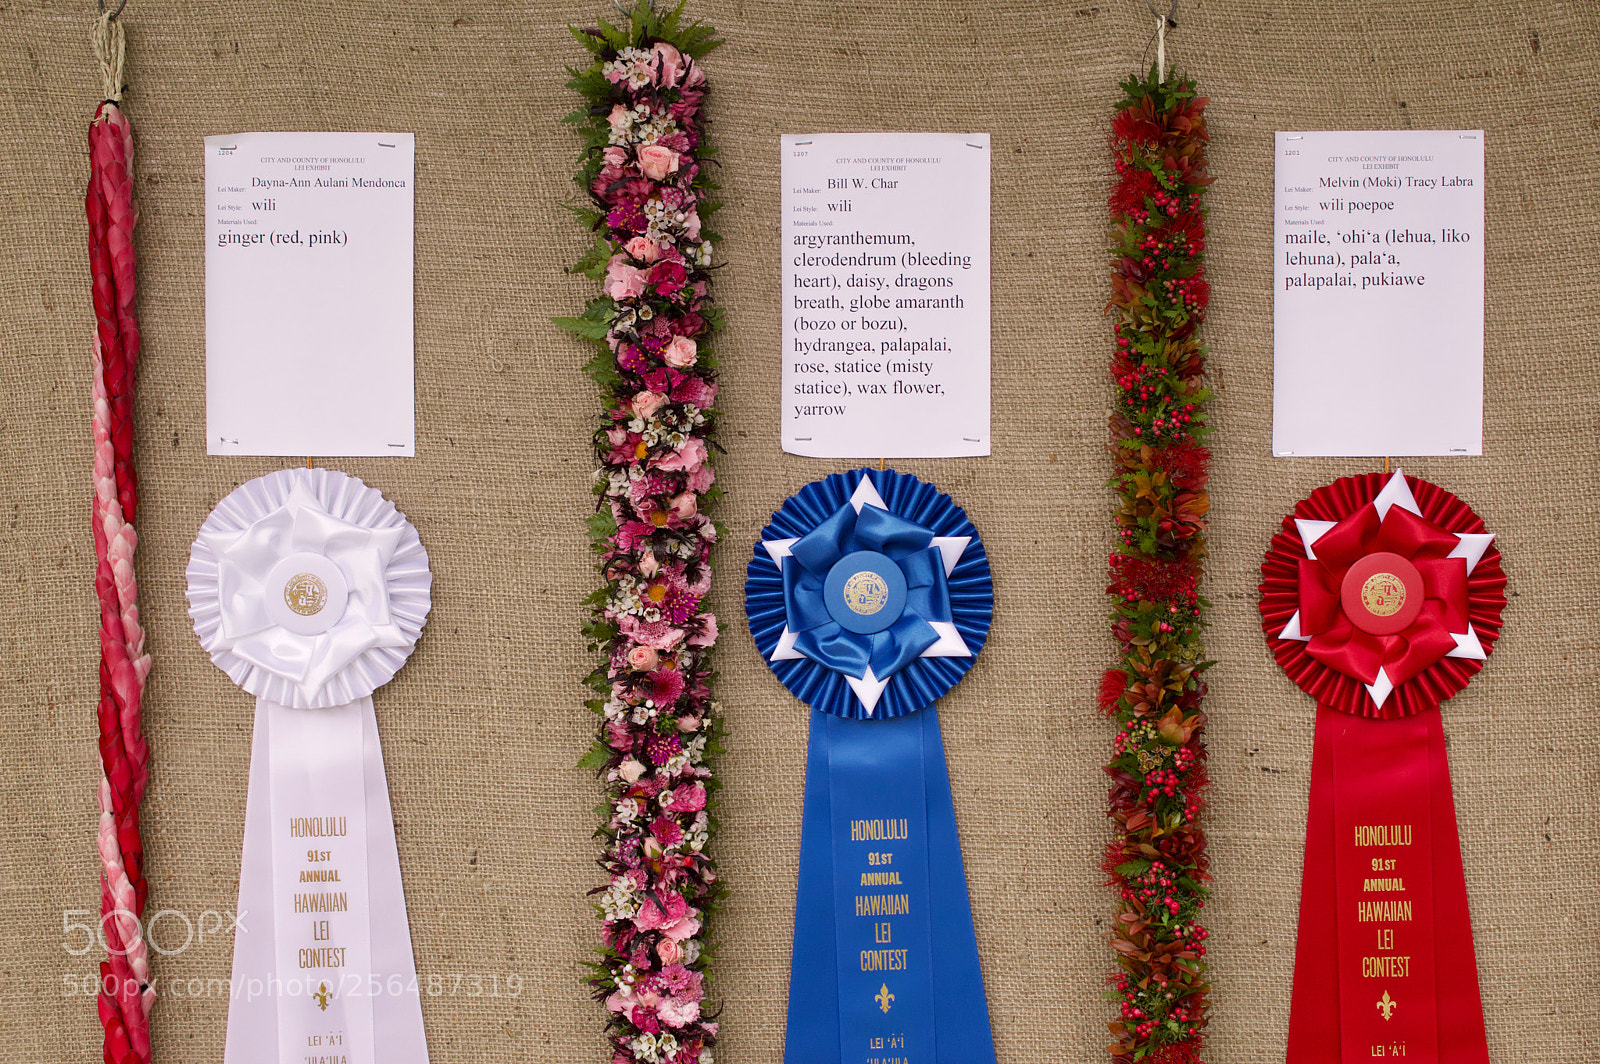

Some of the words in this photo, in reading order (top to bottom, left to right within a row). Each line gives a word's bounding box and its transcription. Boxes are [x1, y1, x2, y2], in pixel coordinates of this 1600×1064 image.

[252, 177, 310, 190] Dayna-Ann
[314, 177, 348, 187] Aulani
[352, 177, 406, 188] Mendonca
[828, 179, 847, 189] Bill
[853, 179, 867, 189] W.
[872, 178, 898, 189] Char
[1319, 177, 1359, 188] Melvin
[1363, 176, 1402, 189] (Moki)
[1405, 176, 1438, 189] Tracy
[1441, 176, 1473, 187] Labra
[252, 199, 276, 210] wili
[828, 200, 852, 212] wili
[1319, 199, 1344, 210] wili
[1348, 201, 1394, 213] poepoe
[218, 230, 265, 247] ginger
[270, 230, 303, 246] (red,
[309, 230, 348, 246] pink)
[794, 231, 915, 248] argyranthemum,
[1285, 230, 1330, 245] maile,
[1386, 229, 1436, 245] (lehua,
[1442, 229, 1470, 243] liko
[794, 252, 896, 266] clerodendrum
[901, 252, 971, 269] (bleeding
[1285, 252, 1345, 267] lehuna),
[794, 274, 841, 289] heart),
[847, 274, 890, 291] daisy,
[895, 274, 953, 290] dragons
[1285, 273, 1356, 290] palapalai,
[1362, 272, 1425, 289] pukiawe
[794, 296, 844, 310] breath,
[850, 295, 890, 312] globe
[895, 295, 964, 309] amaranth
[794, 317, 836, 333] (bozo
[841, 320, 856, 330] or
[862, 317, 907, 332] bozu),
[794, 338, 875, 355] hydrangea,
[881, 338, 951, 355] palapalai,
[794, 363, 828, 374] rose,
[834, 359, 882, 373] statice
[887, 359, 933, 376] (misty
[794, 381, 851, 396] statice),
[857, 384, 886, 394] wax
[893, 381, 945, 396] flower,
[794, 404, 846, 419] yarrow
[290, 817, 347, 838] HONOLULU
[851, 819, 908, 841] HONOLULU
[1355, 825, 1412, 846] HONOLULU
[307, 850, 331, 862] 91ST
[868, 853, 892, 865] 91ST
[1372, 859, 1396, 871] 91ST
[299, 870, 341, 883] ANNUAL
[861, 872, 902, 886] ANNUAL
[1364, 878, 1405, 891] ANNUAL
[294, 892, 348, 913] HAWAIIAN
[855, 894, 909, 916] HAWAIIAN
[1358, 901, 1412, 922] HAWAIIAN
[314, 921, 329, 940] LEI
[875, 923, 891, 943] LEI
[1378, 929, 1394, 950] LEI
[299, 947, 346, 969] CONTEST
[860, 949, 908, 971] CONTEST
[1363, 957, 1410, 977] CONTEST
[308, 1036, 322, 1046] LEI
[870, 1038, 883, 1049] LEI
[1372, 1046, 1385, 1056] LEI
